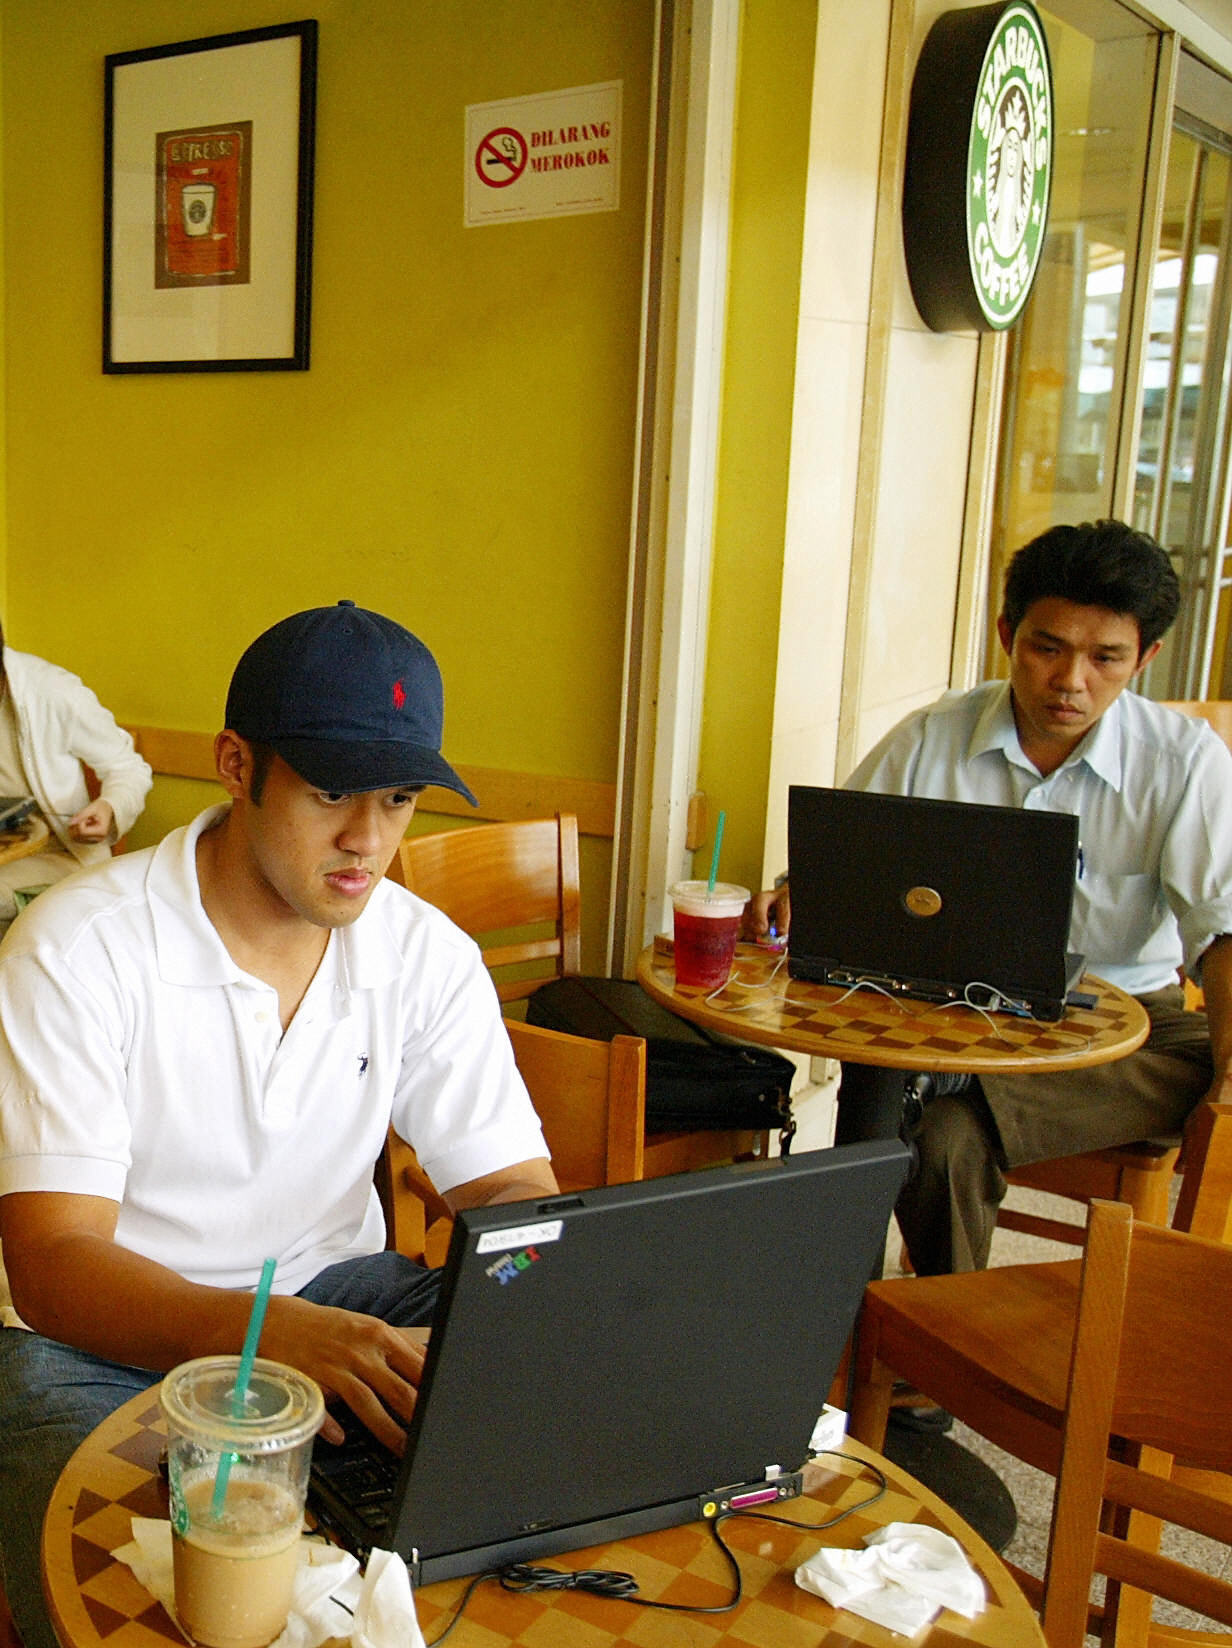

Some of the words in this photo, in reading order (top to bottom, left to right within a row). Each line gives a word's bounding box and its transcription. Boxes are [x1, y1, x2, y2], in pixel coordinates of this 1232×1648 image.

[977, 26, 1047, 171] STARBUCKS
[531, 121, 611, 148] DILARANG
[530, 148, 610, 173] MEROKOK
[974, 222, 1029, 306] COFFEE
[495, 1246, 542, 1286] IBM
